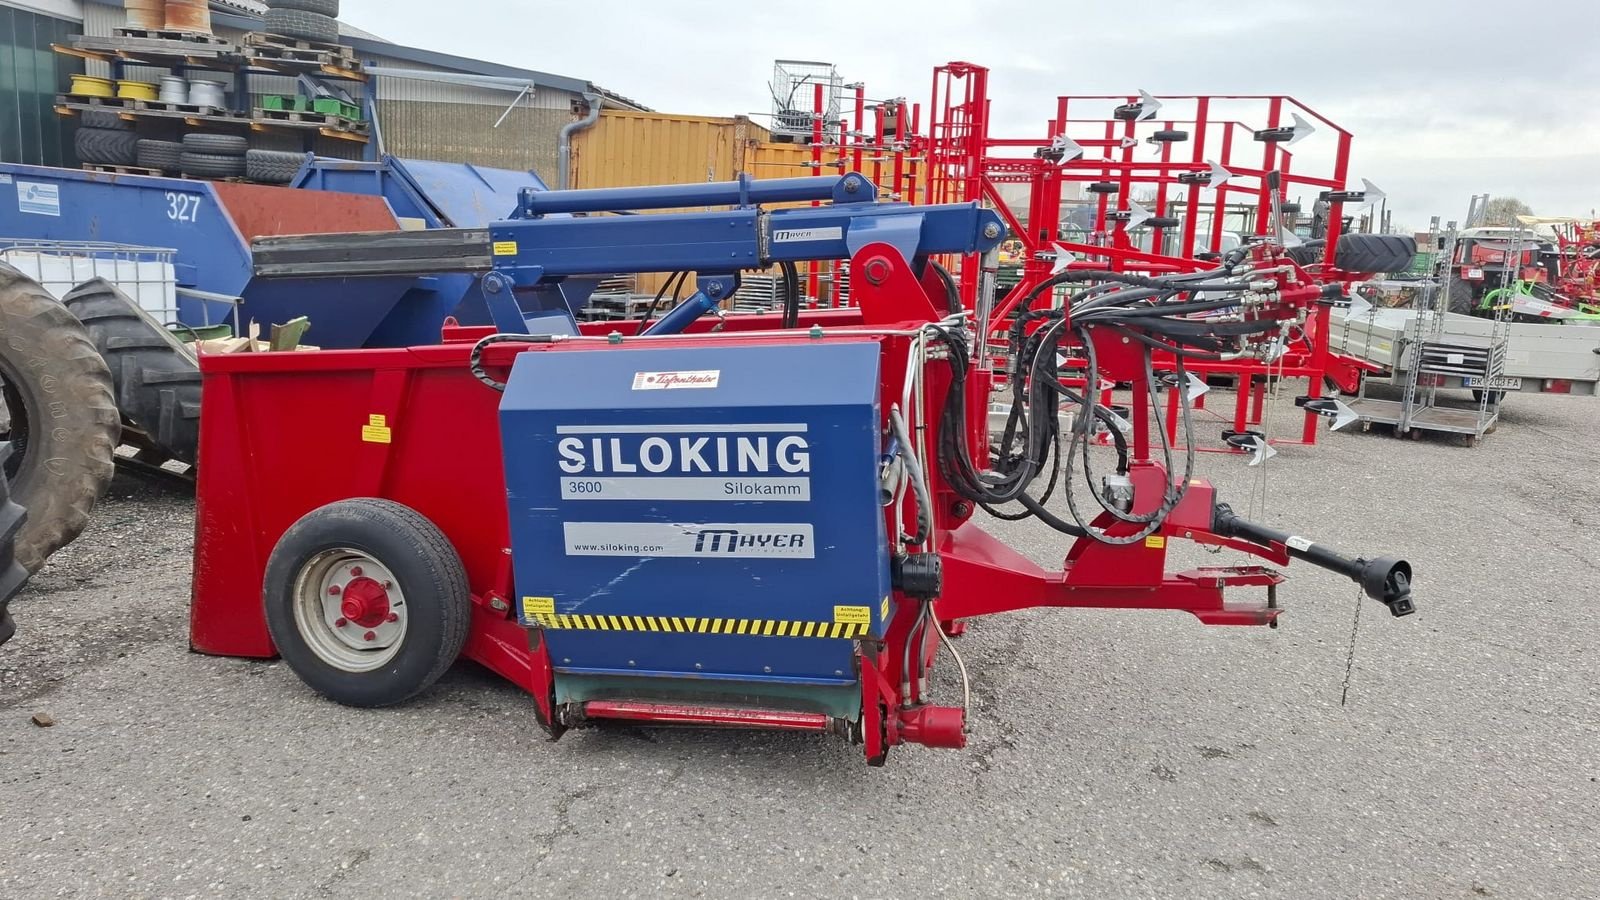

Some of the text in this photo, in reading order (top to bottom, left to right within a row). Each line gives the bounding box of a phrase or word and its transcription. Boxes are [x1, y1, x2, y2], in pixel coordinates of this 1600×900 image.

[166, 193, 201, 223] 327
[776, 231, 812, 240] MAYER
[558, 436, 810, 473] SILOKING
[569, 482, 602, 493] 3600
[724, 482, 801, 495] Silokamm
[694, 529, 804, 552] MAYER
[574, 544, 664, 553] www.siloking.com
